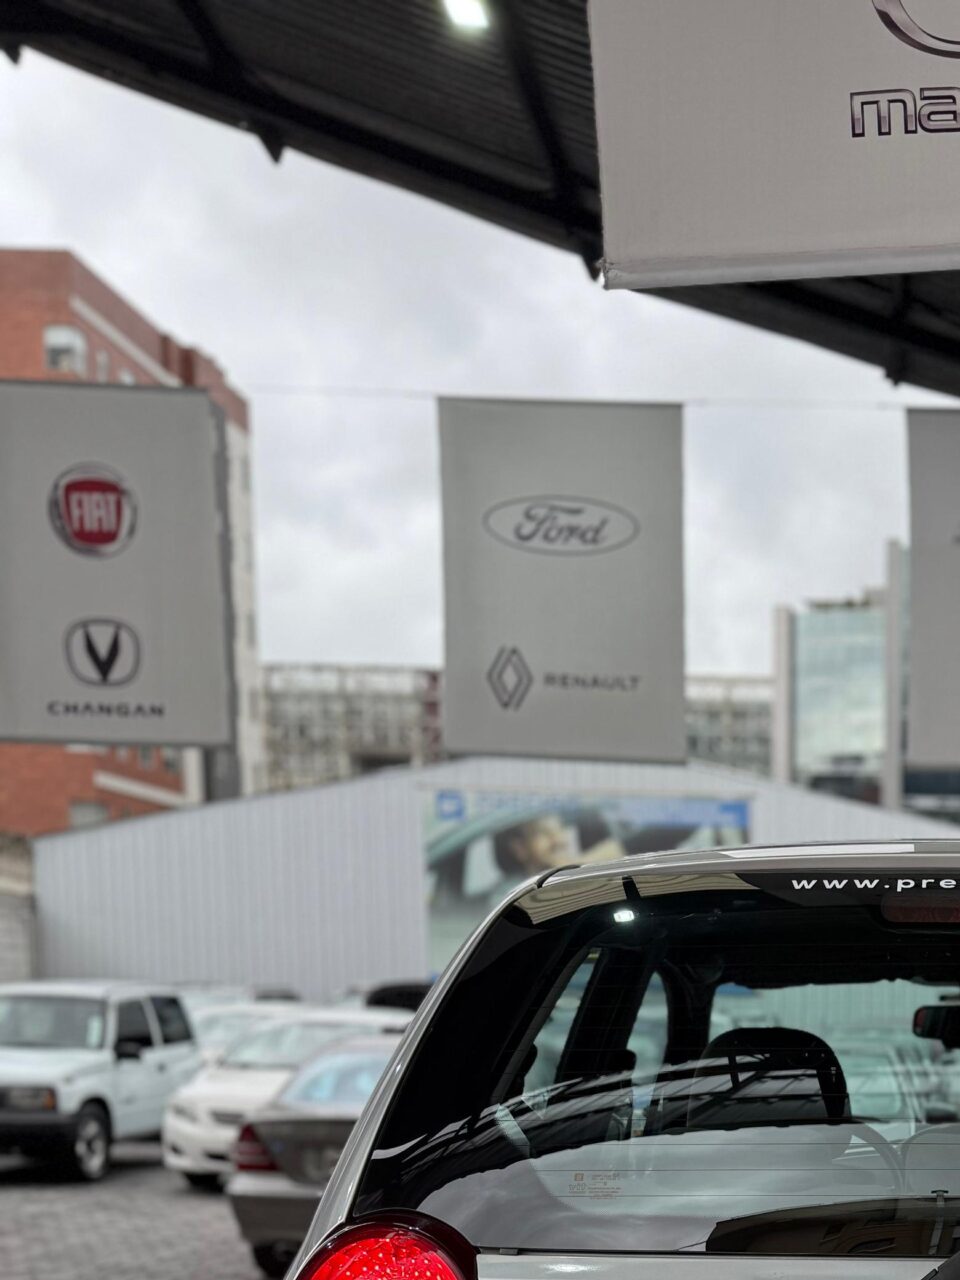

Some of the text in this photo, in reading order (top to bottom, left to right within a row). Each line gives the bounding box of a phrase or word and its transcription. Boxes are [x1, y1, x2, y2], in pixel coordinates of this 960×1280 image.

[69, 491, 118, 533] FIAT
[514, 503, 609, 545] Ford
[543, 672, 641, 692] RENAULT
[47, 701, 165, 718] CHANGAN
